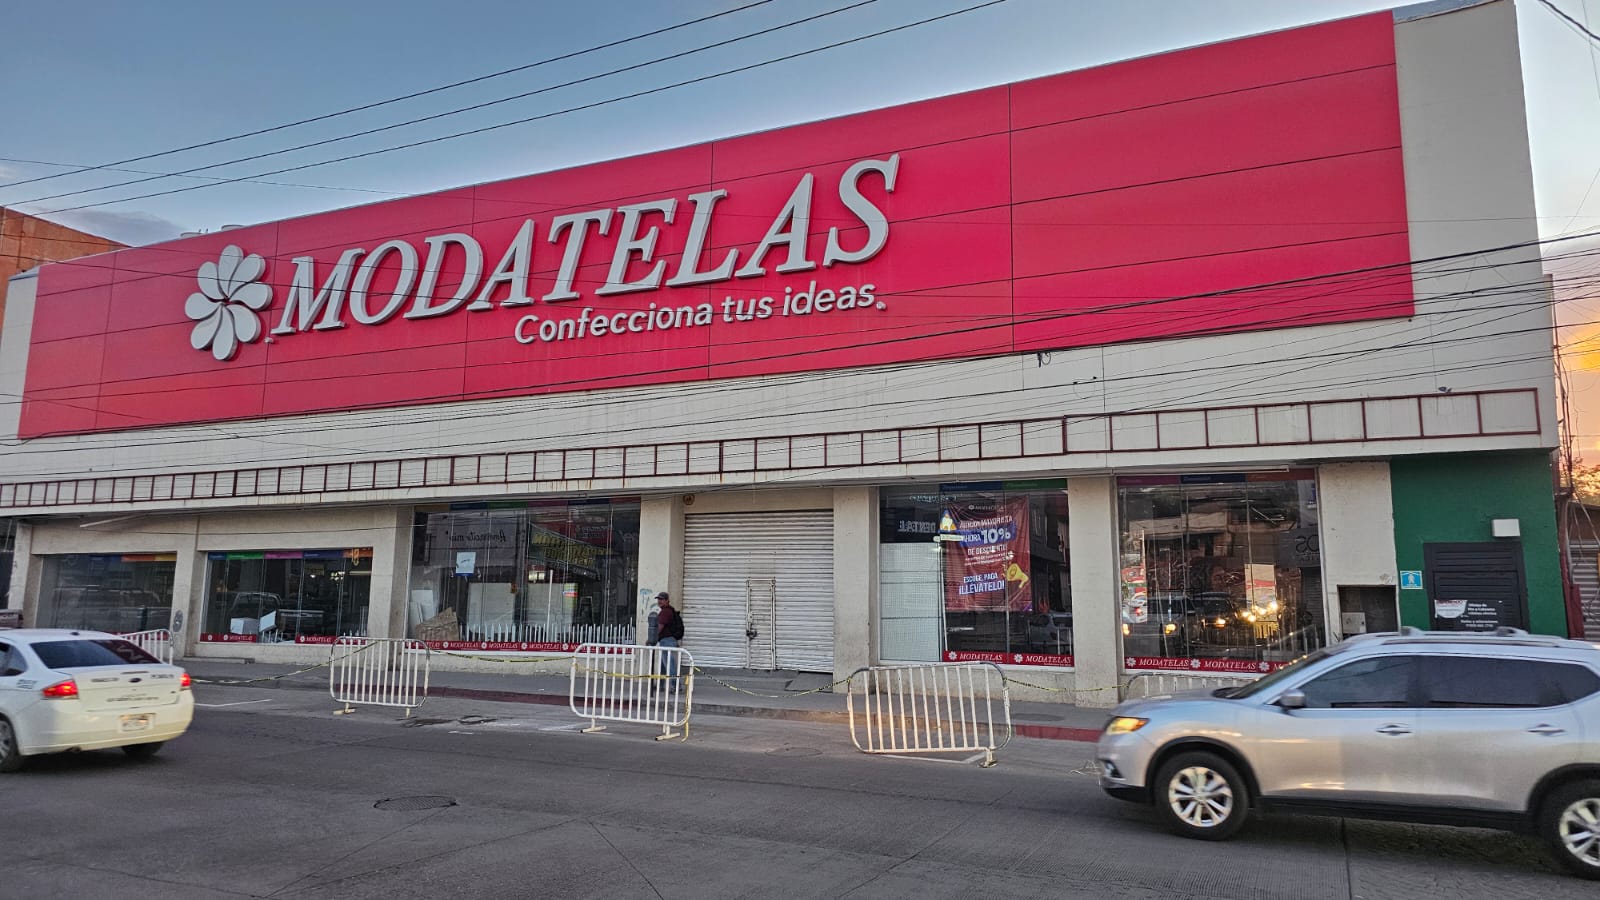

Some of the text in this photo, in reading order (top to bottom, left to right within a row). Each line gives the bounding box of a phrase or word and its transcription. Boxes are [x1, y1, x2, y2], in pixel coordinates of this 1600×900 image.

[273, 153, 900, 335] MODATELAS
[514, 303, 713, 344] Confecciona
[721, 295, 774, 323] tus
[981, 527, 1011, 544] 10%
[959, 652, 1003, 661] MODATELAS
[1025, 655, 1072, 664] MODATELAS
[1138, 658, 1189, 667] MODATELAS
[1203, 660, 1257, 670] MODATELAS
